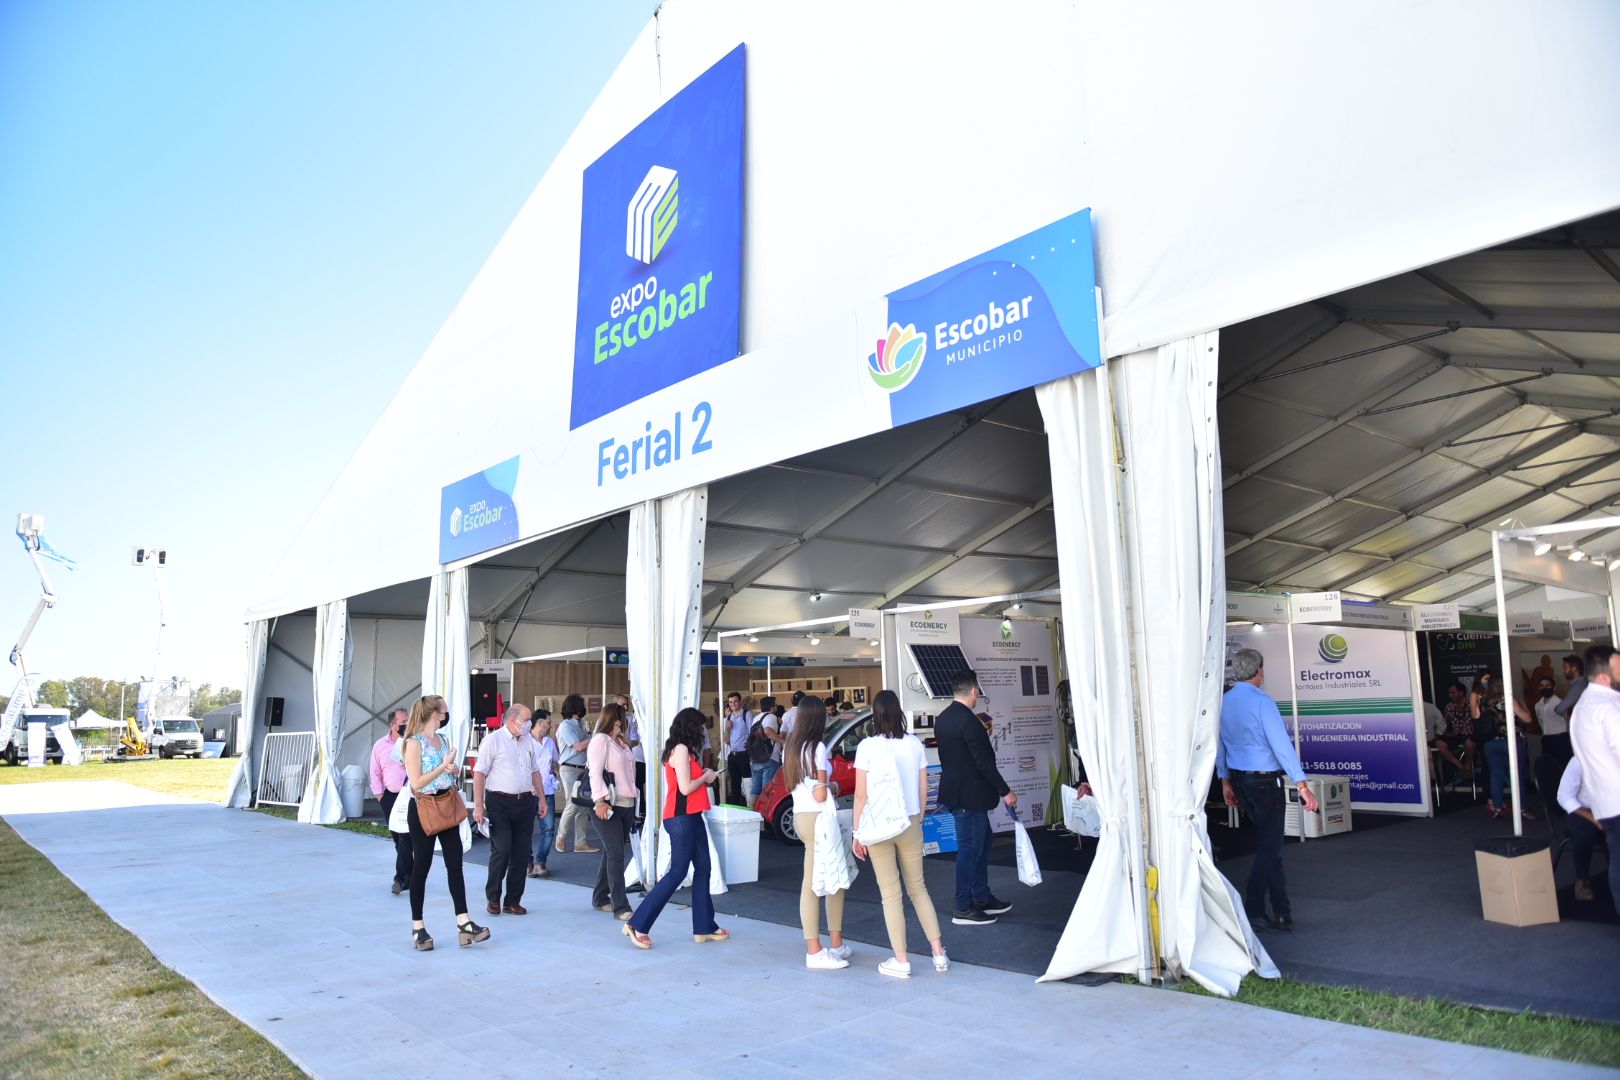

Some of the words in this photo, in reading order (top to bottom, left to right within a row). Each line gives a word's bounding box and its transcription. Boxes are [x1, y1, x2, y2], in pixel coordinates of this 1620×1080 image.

[610, 275, 657, 319] expo
[594, 270, 713, 366] Escobar
[934, 295, 1033, 351] Escobar
[946, 329, 1023, 366] MUNICIPIO
[597, 410, 682, 488] Ferial
[691, 400, 713, 456] 2
[469, 499, 486, 514] expo
[463, 505, 504, 532] Escobar
[1324, 593, 1339, 601] 126
[854, 621, 876, 629] ECOENERGY
[910, 621, 948, 630] ECOENERGY
[992, 641, 1021, 649] ECOENERGY
[1300, 669, 1371, 681] Electromax
[1325, 681, 1367, 690] Industriales
[1368, 679, 1383, 688] SRL
[1311, 734, 1357, 743] INGENIERIA
[1358, 733, 1409, 742] INDUSTRIAL
[1337, 761, 1363, 770] 0085
